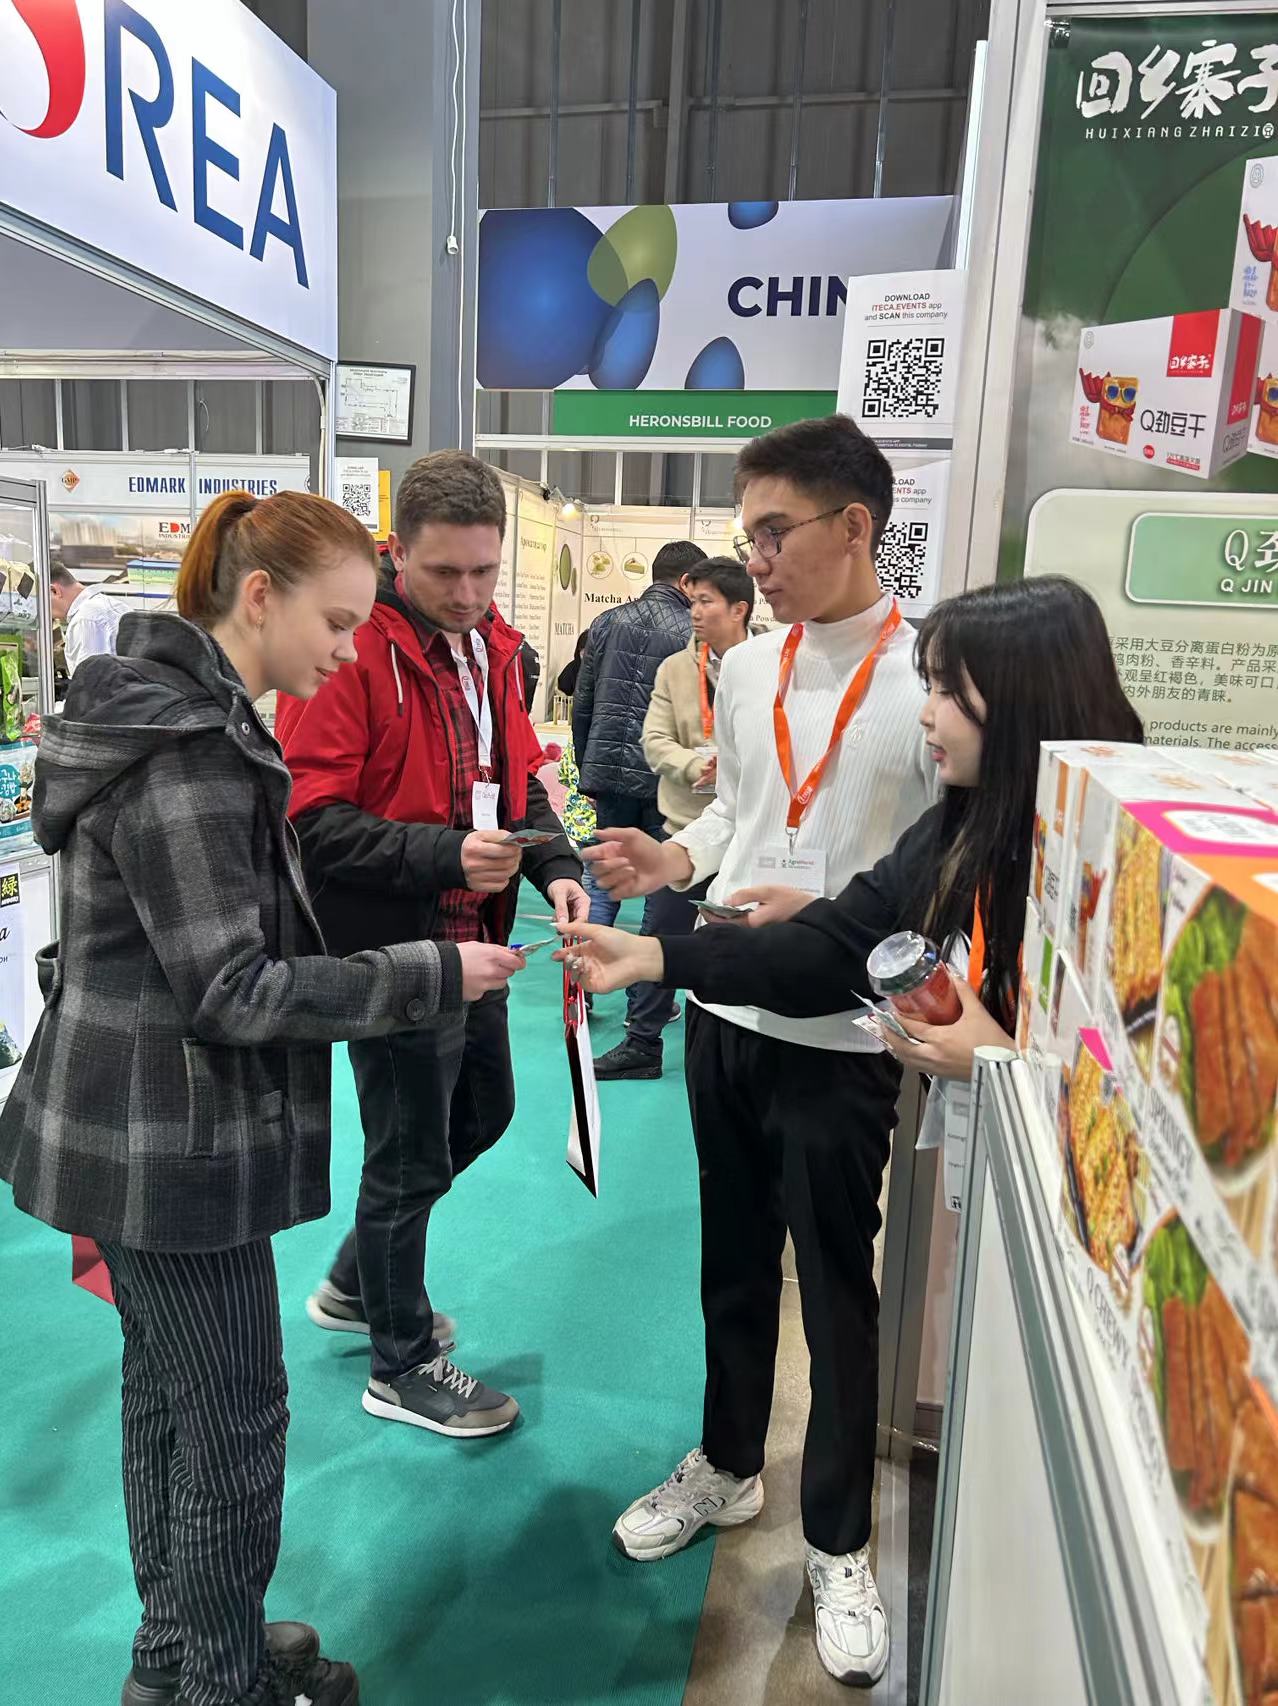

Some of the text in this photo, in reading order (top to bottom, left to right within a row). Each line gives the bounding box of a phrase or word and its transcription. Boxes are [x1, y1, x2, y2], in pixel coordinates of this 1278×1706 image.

[884, 292, 931, 302] DOWNLOAD
[864, 310, 948, 321] and SCAN this company
[628, 413, 772, 428] HERONSBILL FOOD
[1140, 409, 1207, 438] Q劲豆干
[128, 476, 278, 496] EDMARK INDUSTRIES
[913, 488, 927, 496] app
[901, 495, 932, 505] company
[1220, 578, 1273, 594] Q JIN
[584, 592, 622, 604] Matcha
[1150, 719, 1278, 739] products are mainly
[1207, 736, 1230, 750] The
